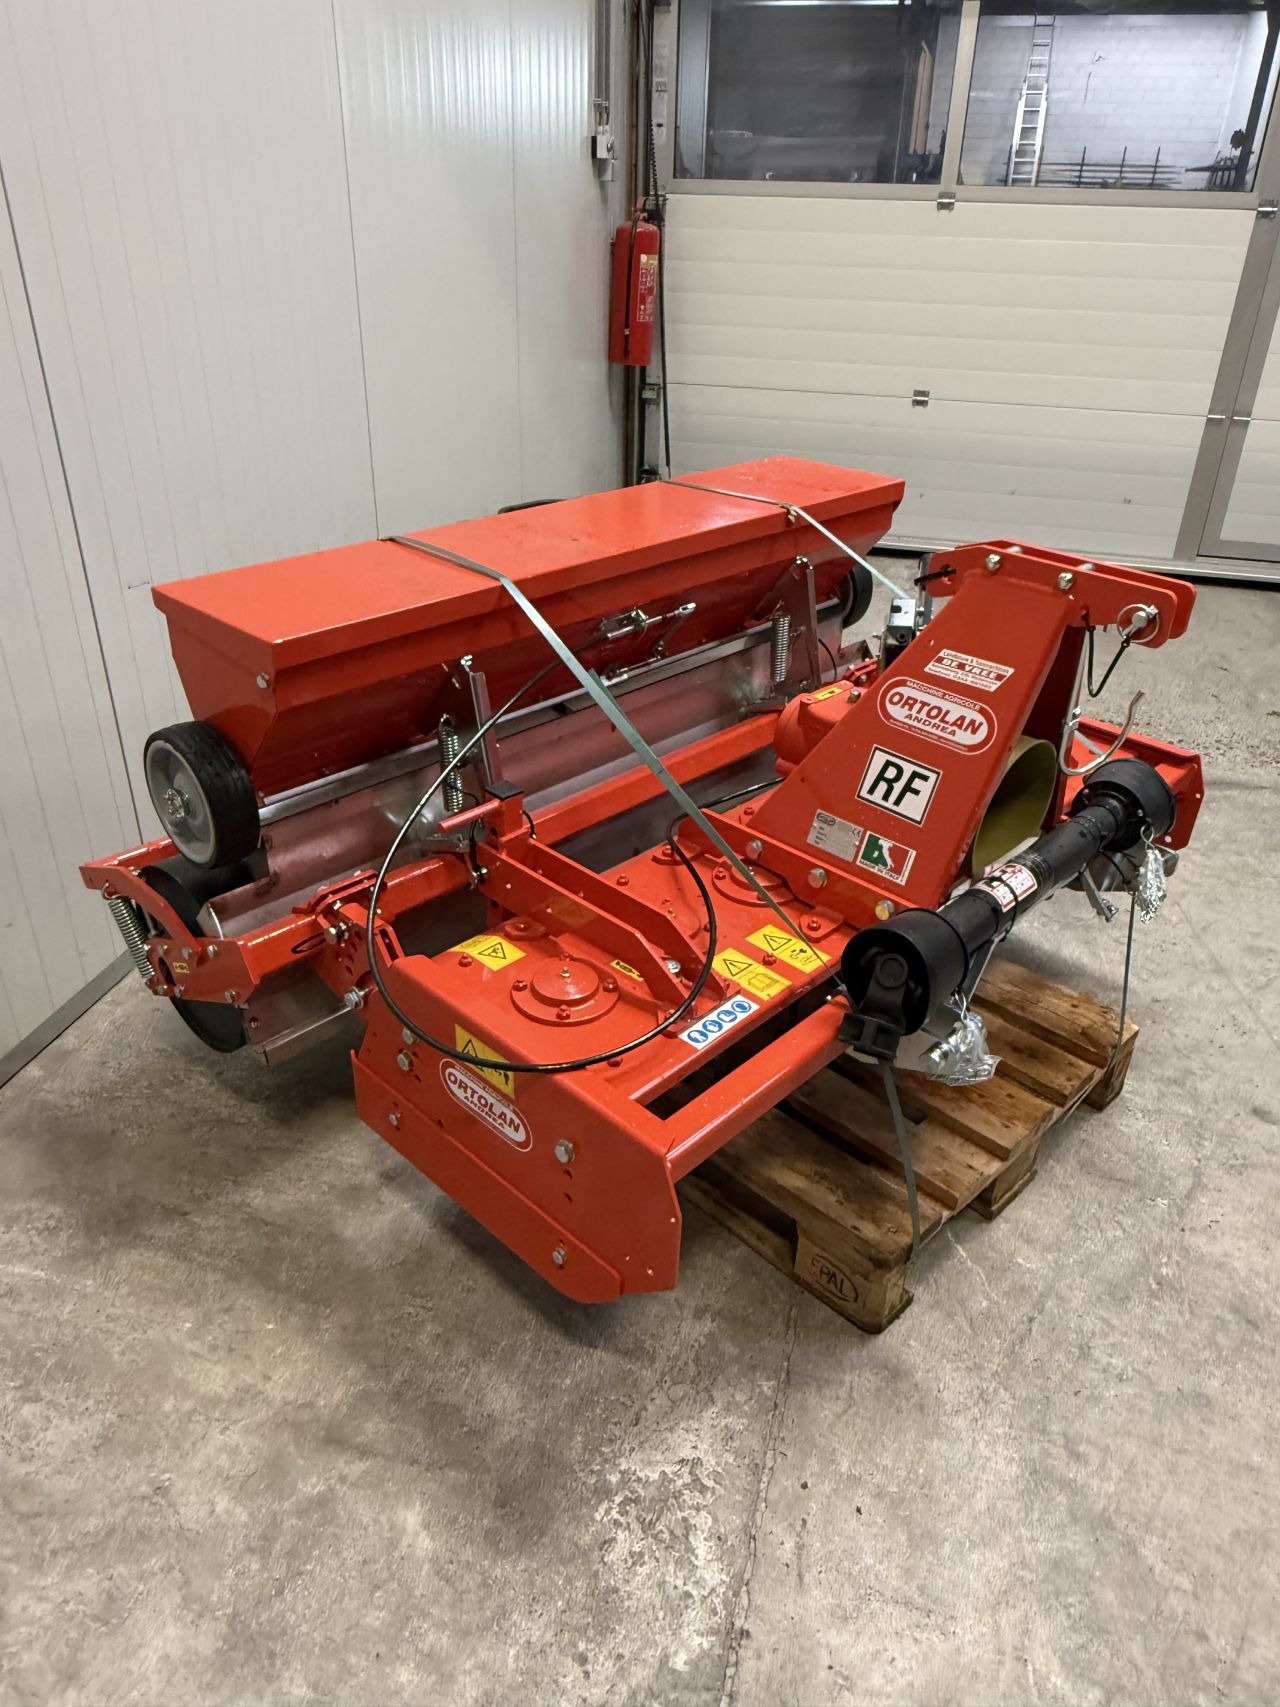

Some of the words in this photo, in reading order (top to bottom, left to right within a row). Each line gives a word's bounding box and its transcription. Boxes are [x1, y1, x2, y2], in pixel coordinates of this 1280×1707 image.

[888, 691, 984, 736] ORTOLAN
[906, 680, 943, 699] MACCHINE
[944, 694, 981, 711] AGRICOLE
[903, 713, 957, 737] ANDREA
[866, 758, 931, 808] RF
[447, 1072, 521, 1134] ORTOLAN
[463, 1095, 506, 1129] ANDREA
